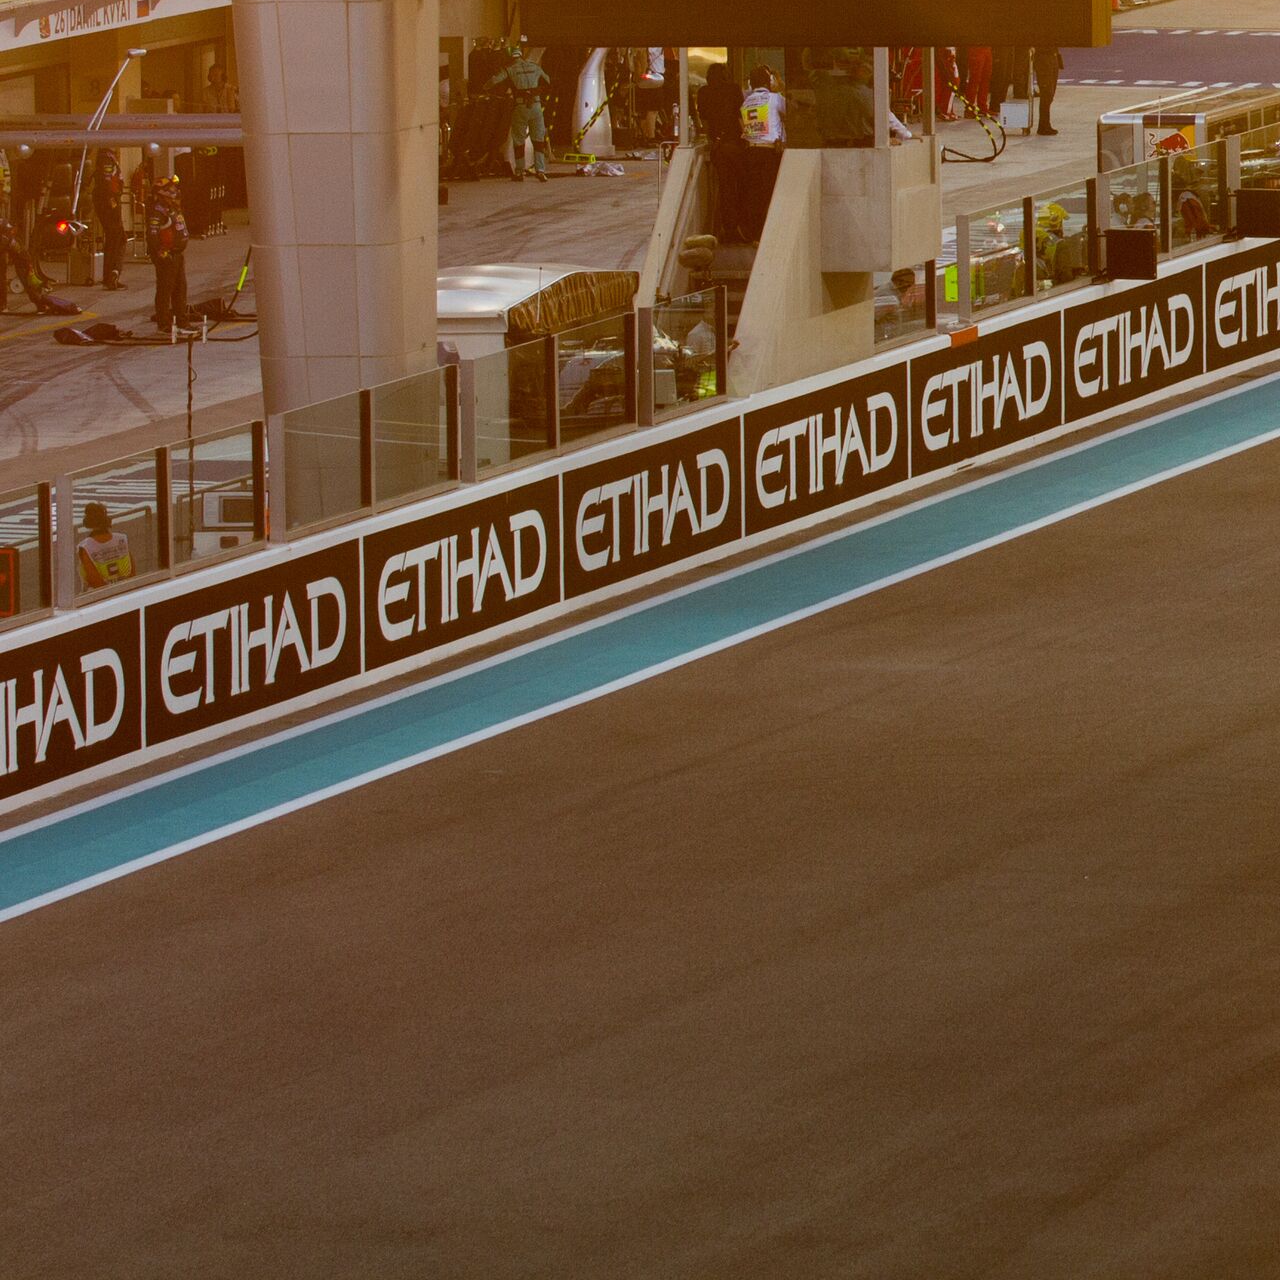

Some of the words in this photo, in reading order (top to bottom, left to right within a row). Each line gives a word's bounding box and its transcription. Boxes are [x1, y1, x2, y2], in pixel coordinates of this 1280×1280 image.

[921, 340, 1052, 452] ETIHAD
[1073, 293, 1195, 398] ETIHAD
[575, 448, 731, 572] ETIHAD
[755, 391, 898, 509] ETIHAD
[377, 509, 547, 642] ETIHAD
[160, 576, 347, 715] ETIHAD
